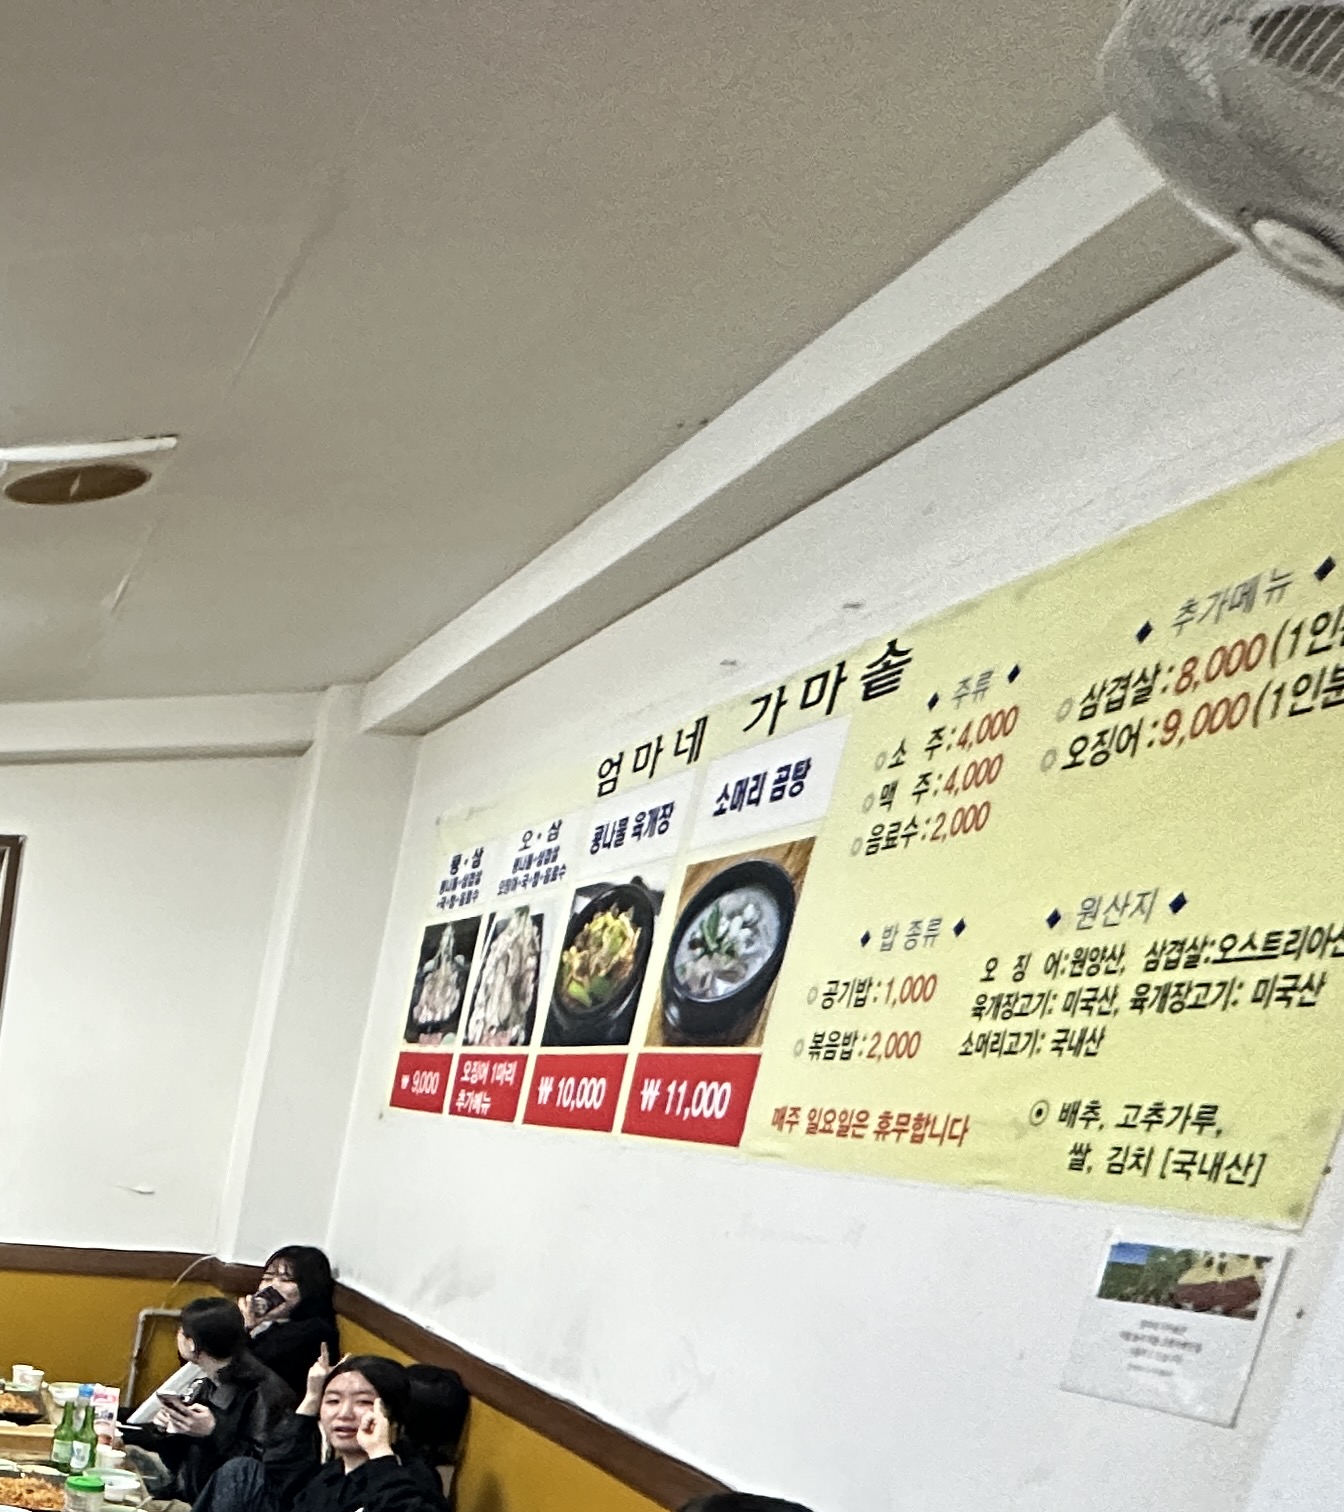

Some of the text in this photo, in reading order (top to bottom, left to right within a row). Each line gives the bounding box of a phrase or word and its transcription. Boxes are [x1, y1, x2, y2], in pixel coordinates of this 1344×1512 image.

[1170, 568, 1295, 637] 추가메뉴
[1078, 604, 1344, 721] 삼겹살:8,000(1인
[743, 638, 913, 737] 가마솥
[952, 671, 994, 708] 주류
[713, 757, 812, 817] 소머리 곰탕
[589, 816, 630, 855] 콩나물
[1076, 887, 1159, 930] 원산지
[904, 917, 943, 950] 종류
[1251, 972, 1328, 1009] 미국산
[1050, 1027, 1105, 1058] 국내산
[411, 1071, 439, 1095] 9,000
[556, 1077, 606, 1112] 10,000
[664, 1080, 732, 1121] 11,000
[806, 1107, 869, 1138] 일요일은
[873, 1111, 970, 1147] 휴무합니다
[1106, 1145, 1155, 1177] 김치
